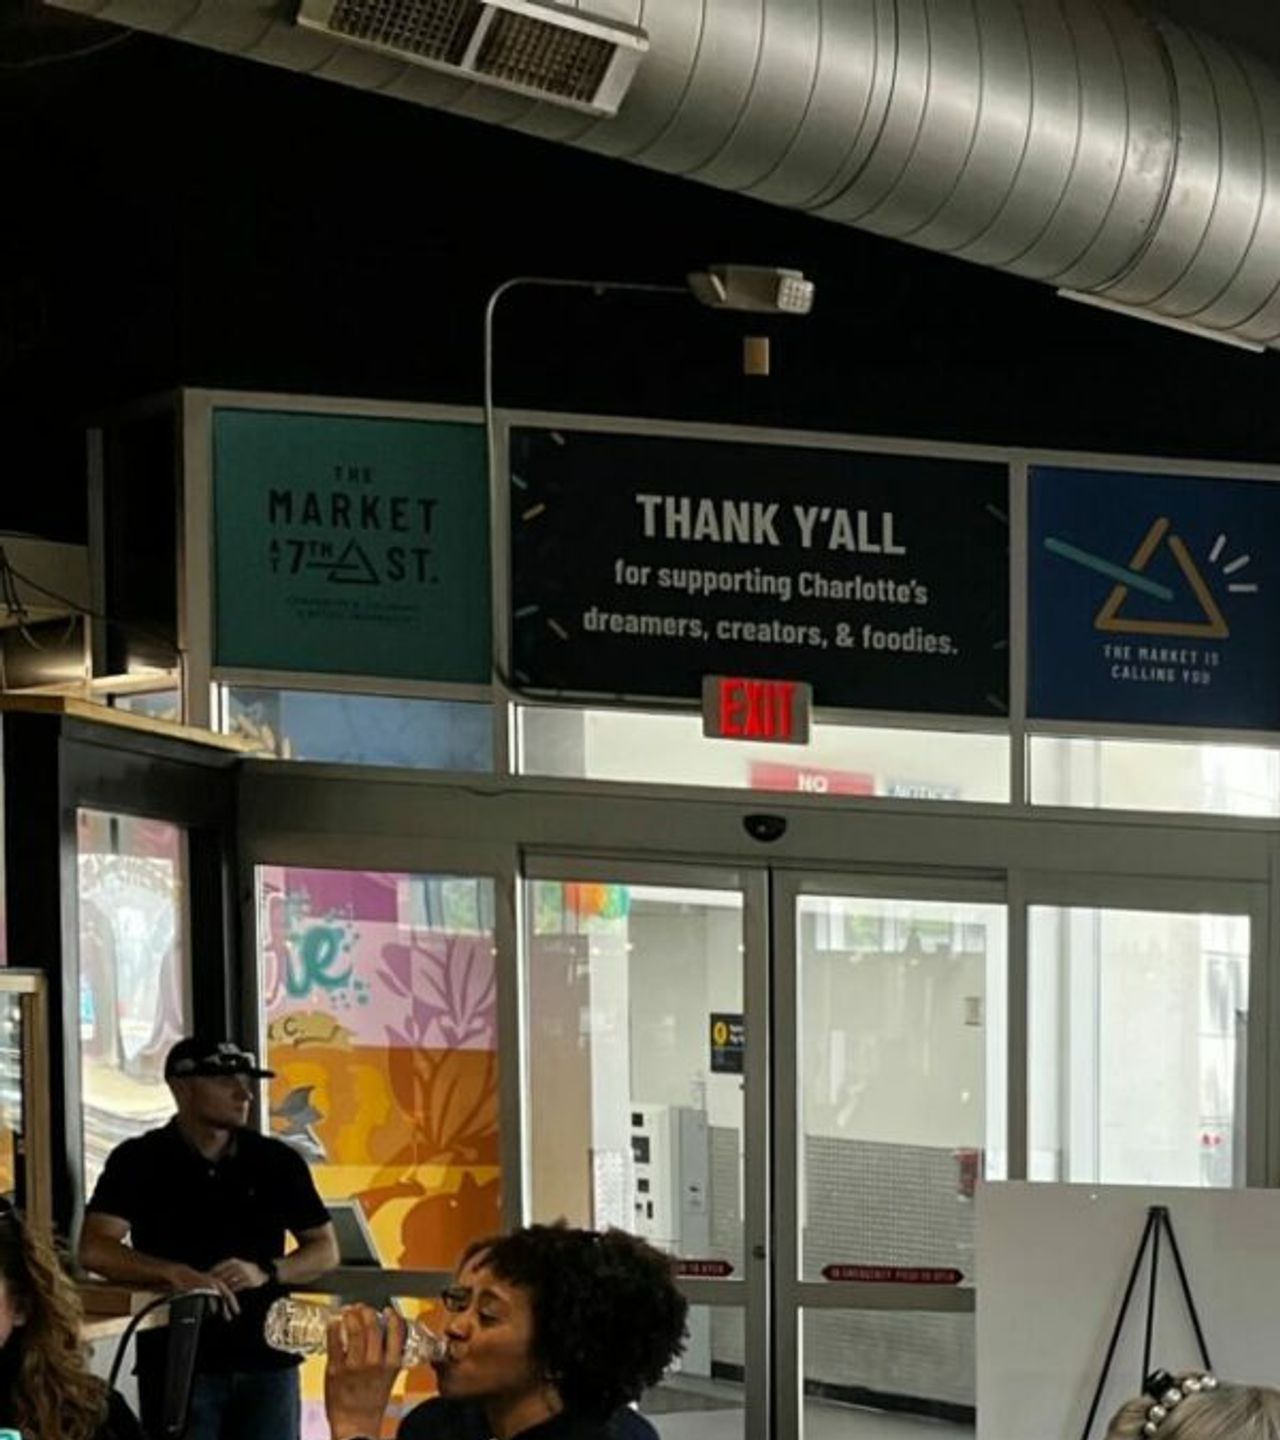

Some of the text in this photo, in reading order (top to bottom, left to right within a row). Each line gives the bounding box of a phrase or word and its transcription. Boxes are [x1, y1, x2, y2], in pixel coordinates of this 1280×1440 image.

[333, 465, 374, 484] THE
[267, 488, 439, 534] MARKET
[635, 493, 907, 555] THANK Y'ALL
[386, 546, 440, 583] ST.
[613, 557, 928, 605] for supporting Charlotte's
[582, 606, 959, 655] dreamers, creators, & foodies.
[1103, 643, 1132, 660] THE
[1138, 646, 1198, 665] MARKET
[1110, 664, 1176, 683] CALLING
[719, 677, 795, 740] EXIT
[797, 774, 829, 793] NO
